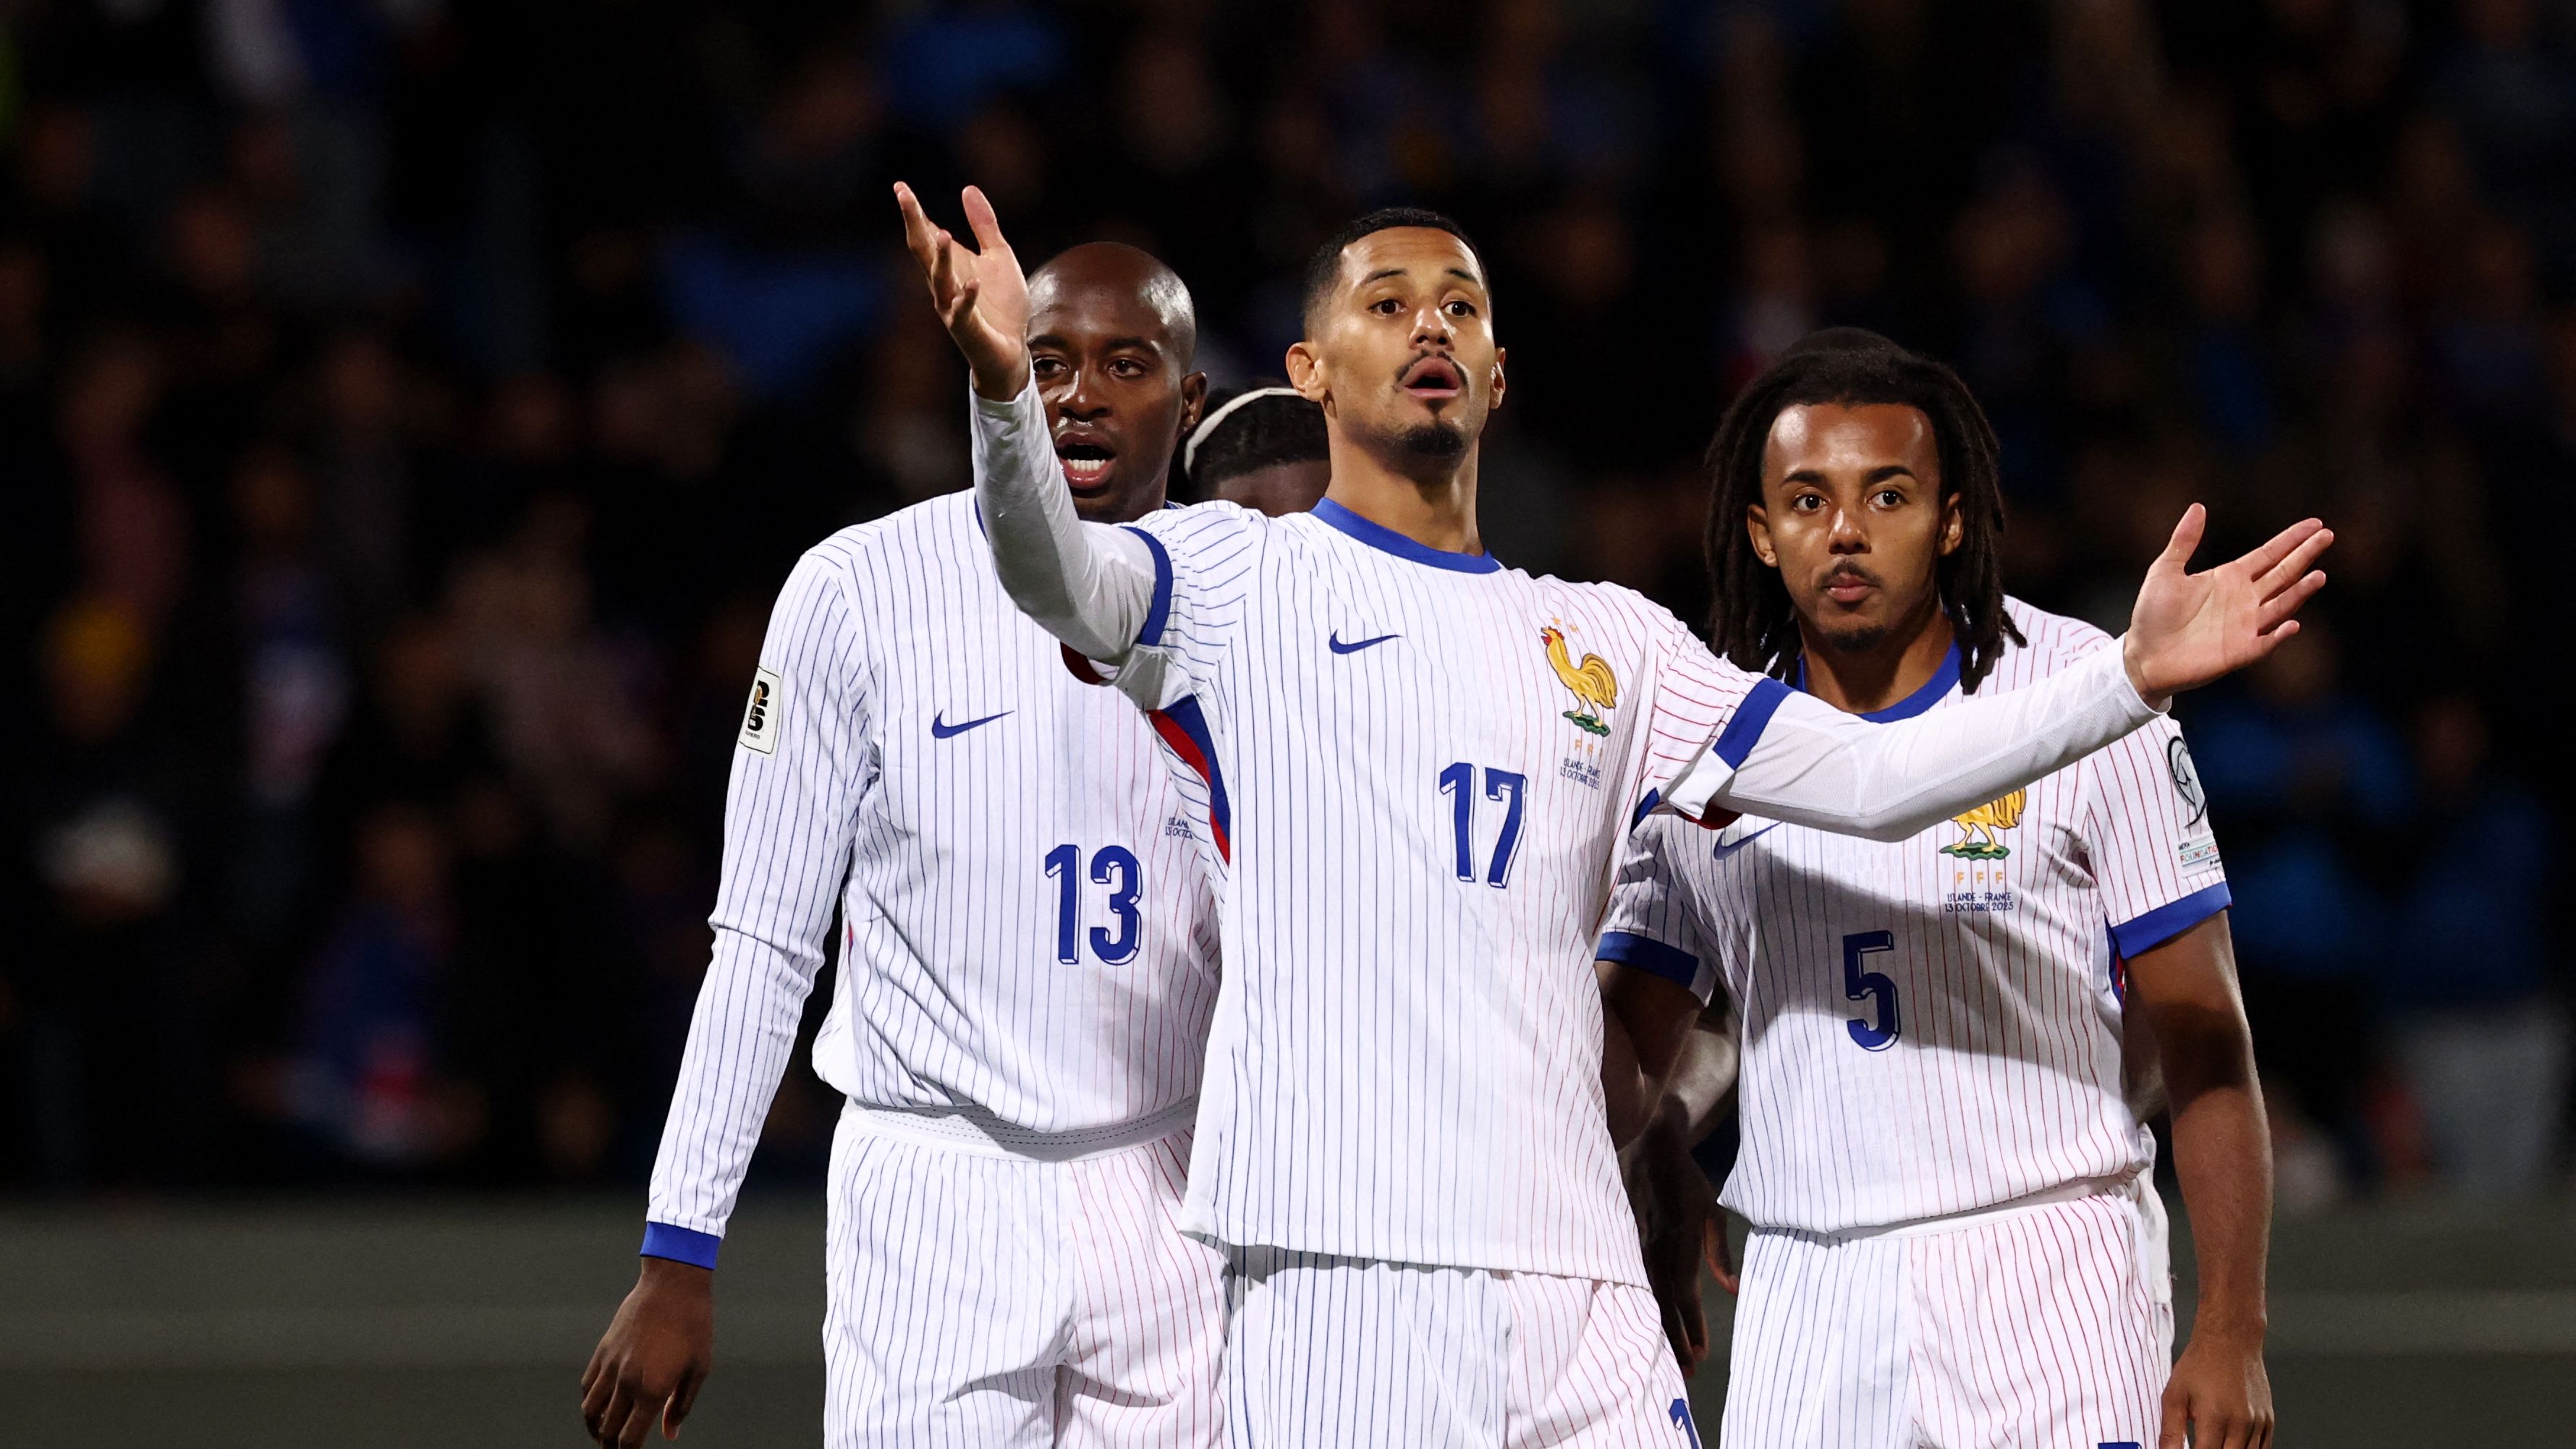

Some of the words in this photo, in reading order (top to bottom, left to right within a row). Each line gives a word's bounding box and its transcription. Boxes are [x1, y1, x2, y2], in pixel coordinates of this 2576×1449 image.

[1439, 762, 1528, 889] 17
[1045, 844, 1143, 966] 13
[1944, 903, 1954, 913] 13
[1956, 902, 1989, 912] OCTOBRE
[1992, 901, 2014, 912] 2025
[1947, 893, 1976, 902] ISLANDE
[1985, 892, 2012, 901] FRANCE
[1843, 930, 1901, 1052] 5
